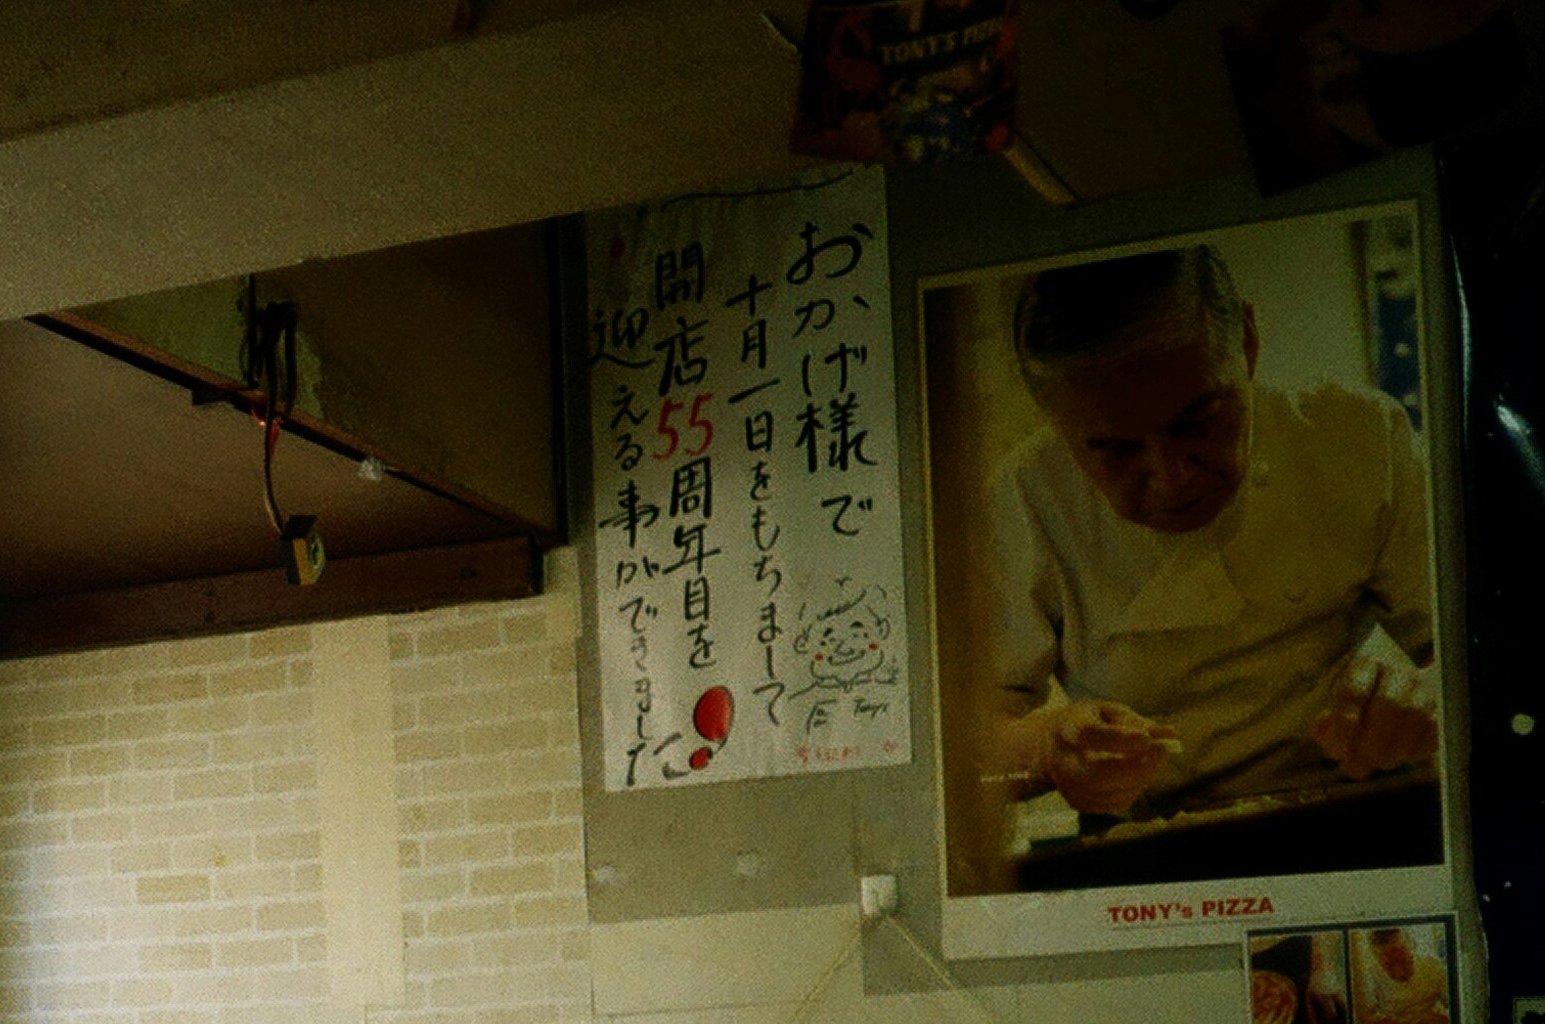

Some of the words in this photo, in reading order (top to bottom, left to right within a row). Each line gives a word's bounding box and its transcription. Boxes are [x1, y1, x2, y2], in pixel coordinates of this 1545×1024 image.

[785, 221, 879, 537] おかげ様で
[1108, 901, 1193, 923] TONY's
[1201, 896, 1275, 917] PIZZA
